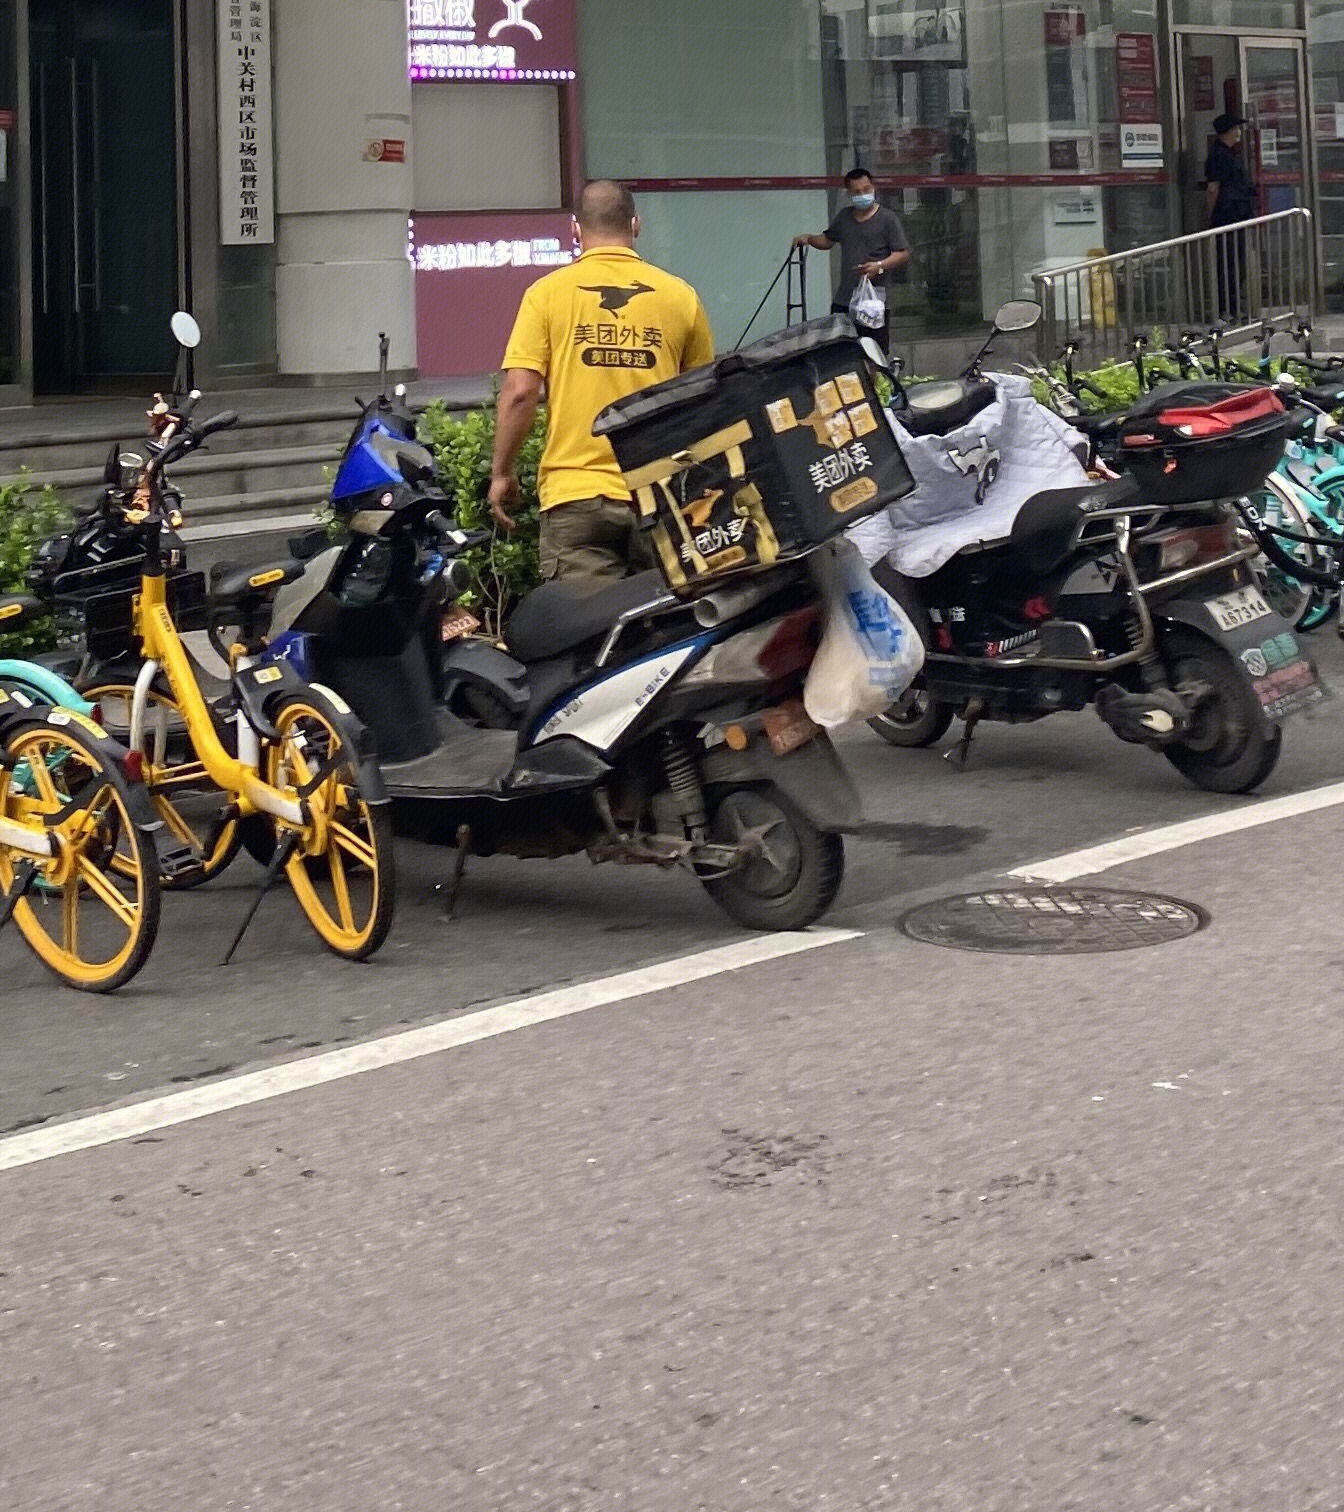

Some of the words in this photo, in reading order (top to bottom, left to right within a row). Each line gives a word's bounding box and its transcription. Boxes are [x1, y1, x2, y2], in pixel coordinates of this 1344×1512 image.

[237, 45, 258, 239] 中关村西区市场监督管理所
[573, 323, 663, 349] 美团外卖
[591, 349, 648, 367] 美团专送
[808, 441, 874, 494] 美团外卖
[635, 666, 671, 707] E-BIKE
